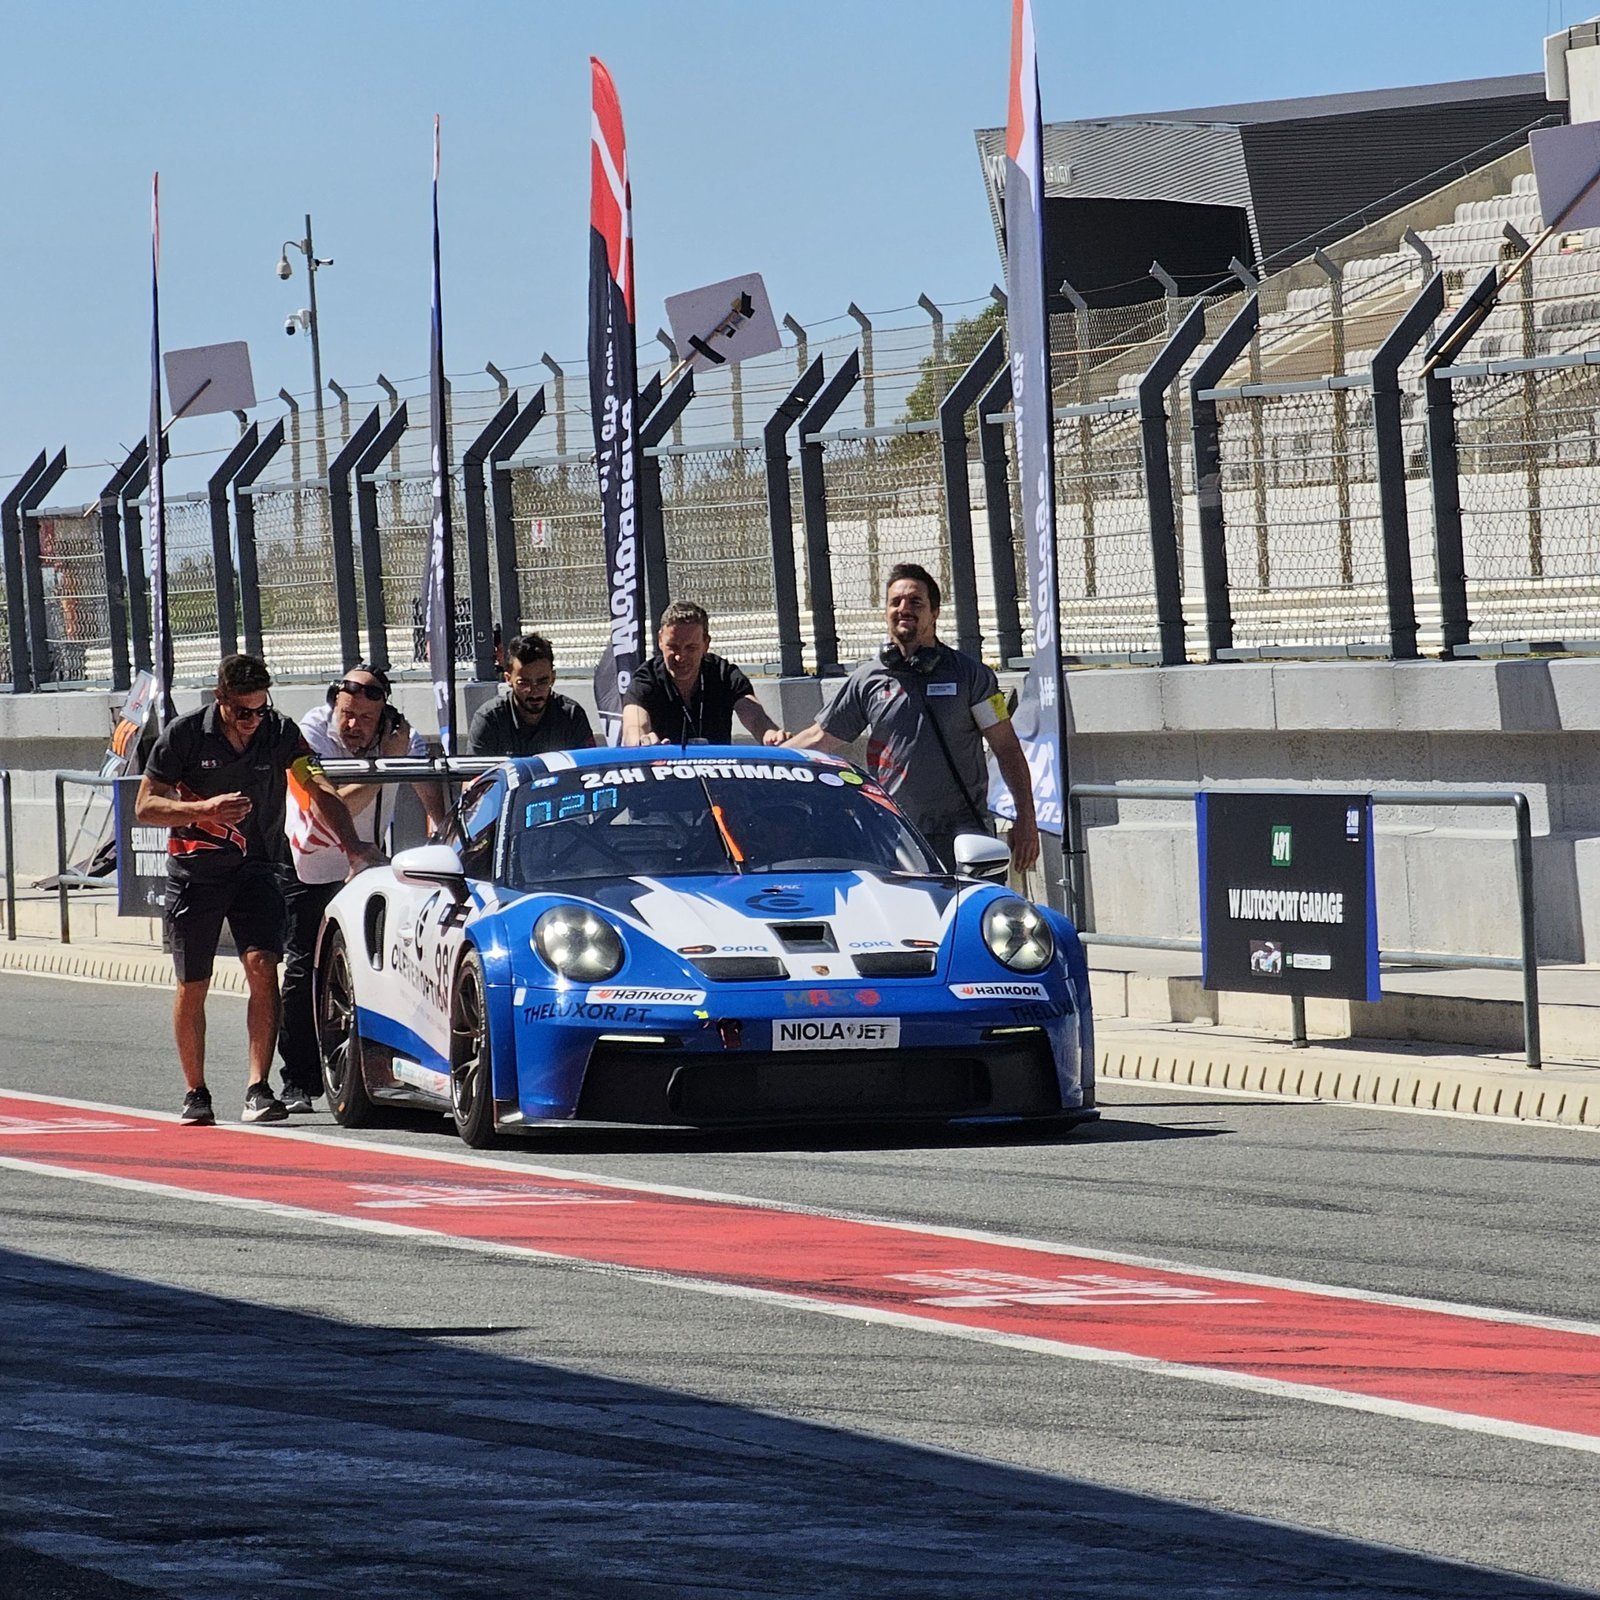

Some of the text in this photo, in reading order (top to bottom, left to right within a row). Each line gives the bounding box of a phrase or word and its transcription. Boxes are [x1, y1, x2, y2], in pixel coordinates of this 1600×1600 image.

[580, 767, 646, 789] 24H
[650, 764, 815, 783] PORTIMAO
[1228, 888, 1343, 924] W AUTOSPORT GARAGE
[523, 1003, 651, 1025] THELUXOR.PT
[780, 1022, 845, 1041] NIOLA
